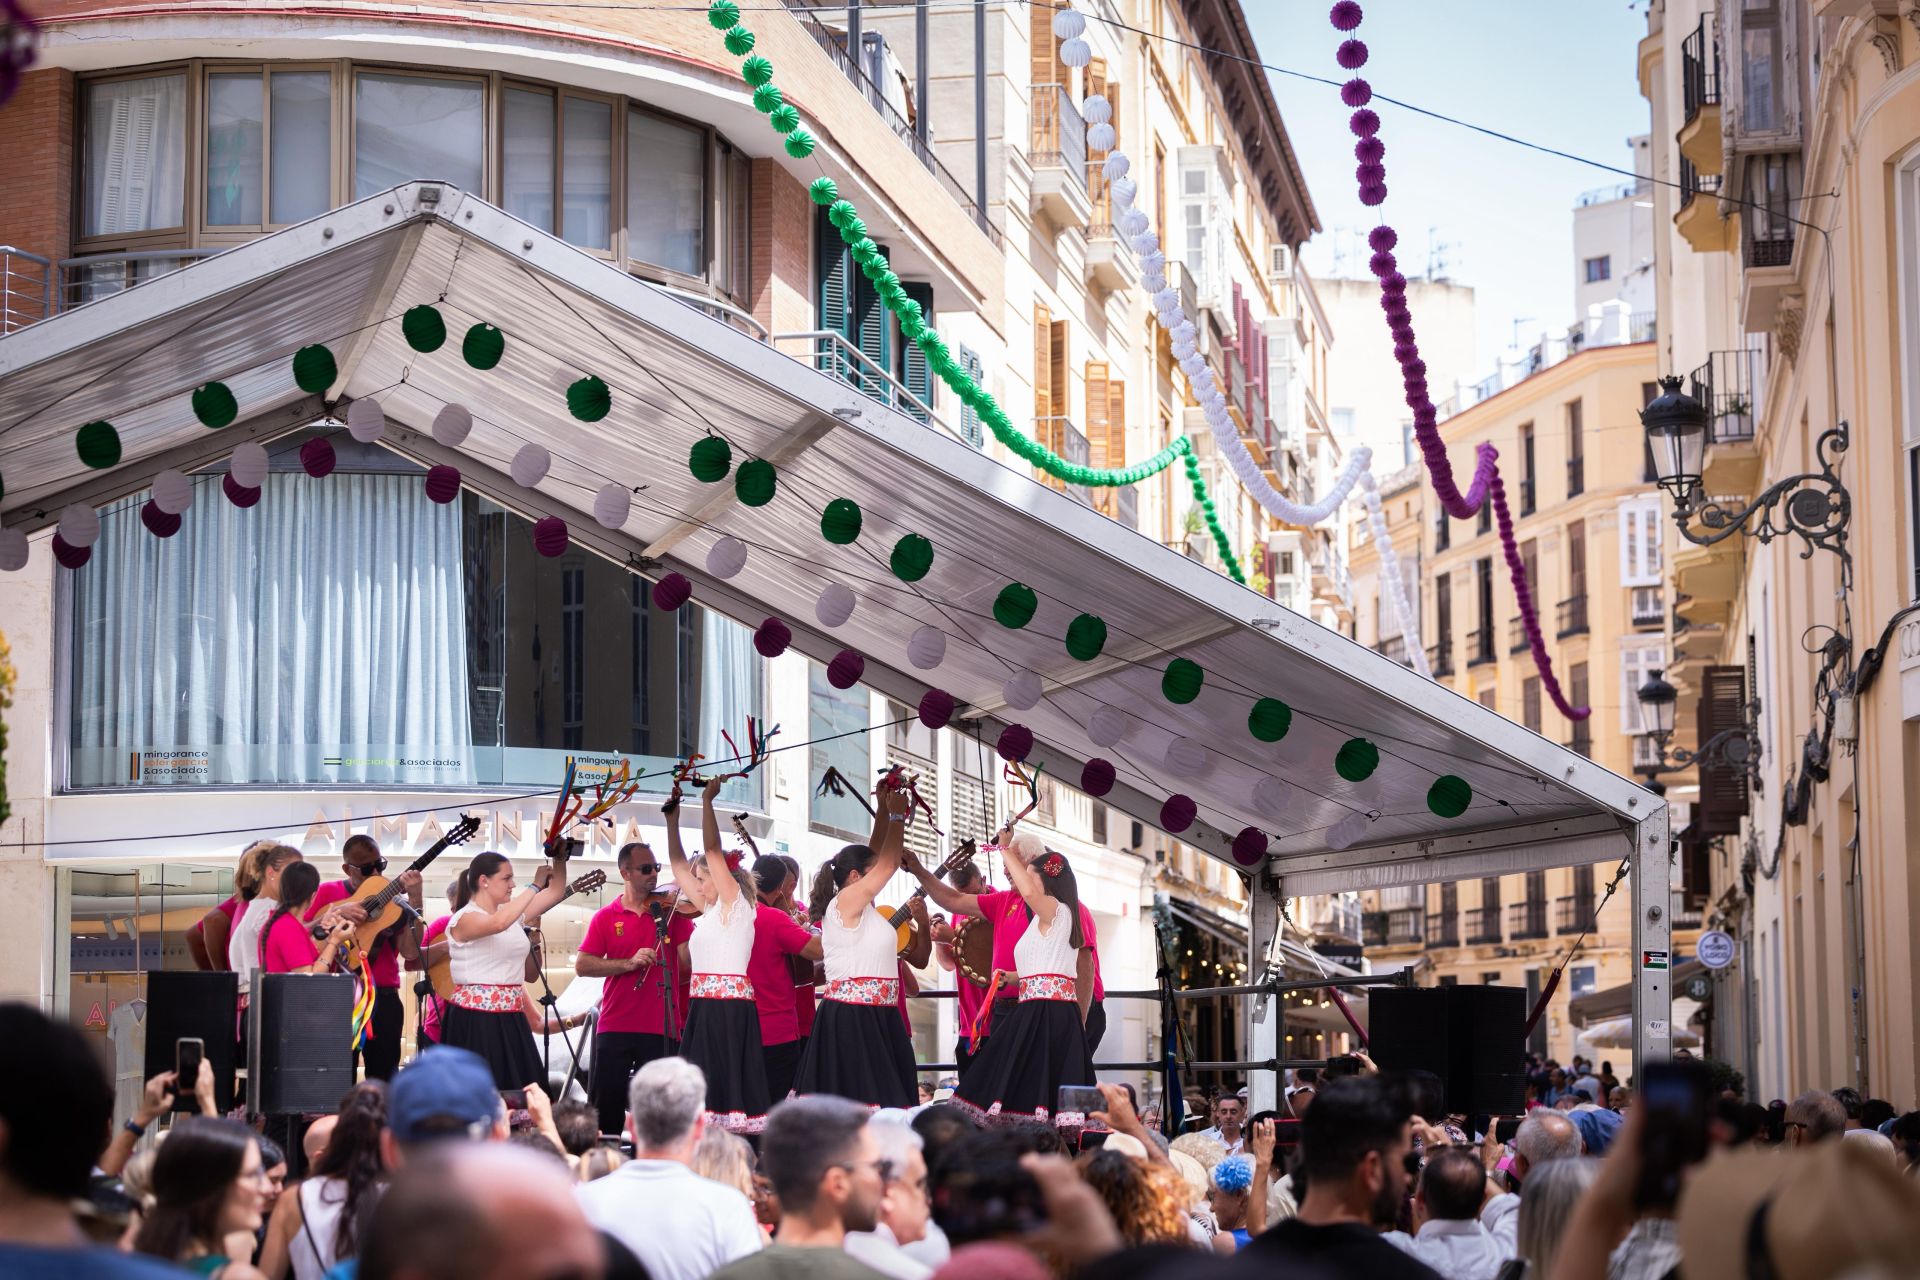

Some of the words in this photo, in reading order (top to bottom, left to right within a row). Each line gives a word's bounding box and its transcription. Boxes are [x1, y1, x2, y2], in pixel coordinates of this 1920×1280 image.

[144, 750, 208, 759] mingorance
[144, 766, 208, 775] &asociados
[304, 806, 446, 843] ALMA
[468, 809, 522, 843] EN
